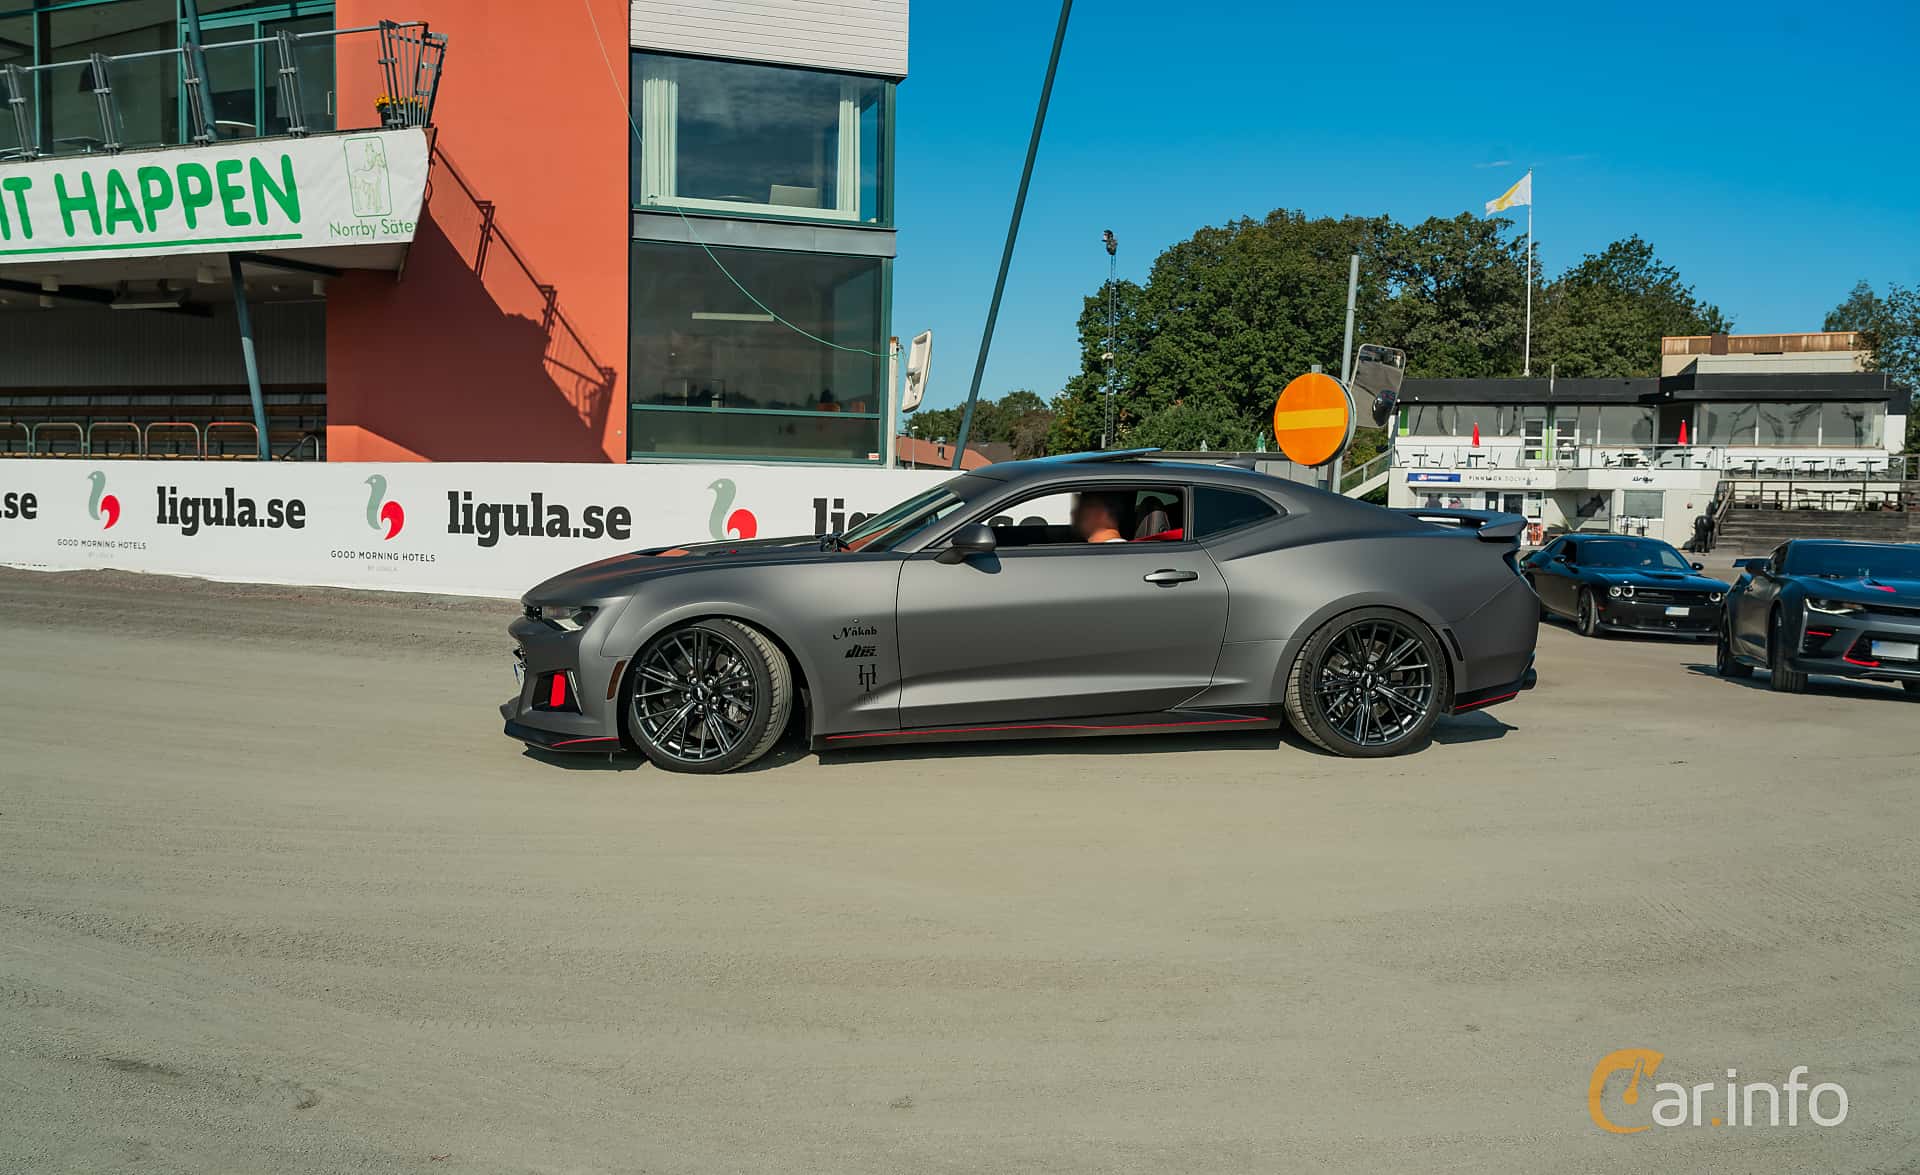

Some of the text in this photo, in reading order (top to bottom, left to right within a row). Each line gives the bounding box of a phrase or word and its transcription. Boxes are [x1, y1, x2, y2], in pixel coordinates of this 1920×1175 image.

[54, 154, 302, 237] HAPPEN
[329, 219, 377, 240] Norrby
[156, 486, 306, 536] ligula.se
[447, 491, 632, 547] ligula.se
[57, 538, 147, 550] GOOD MORNING HOTELS
[330, 550, 436, 562] GOOD MORNING HOTELS
